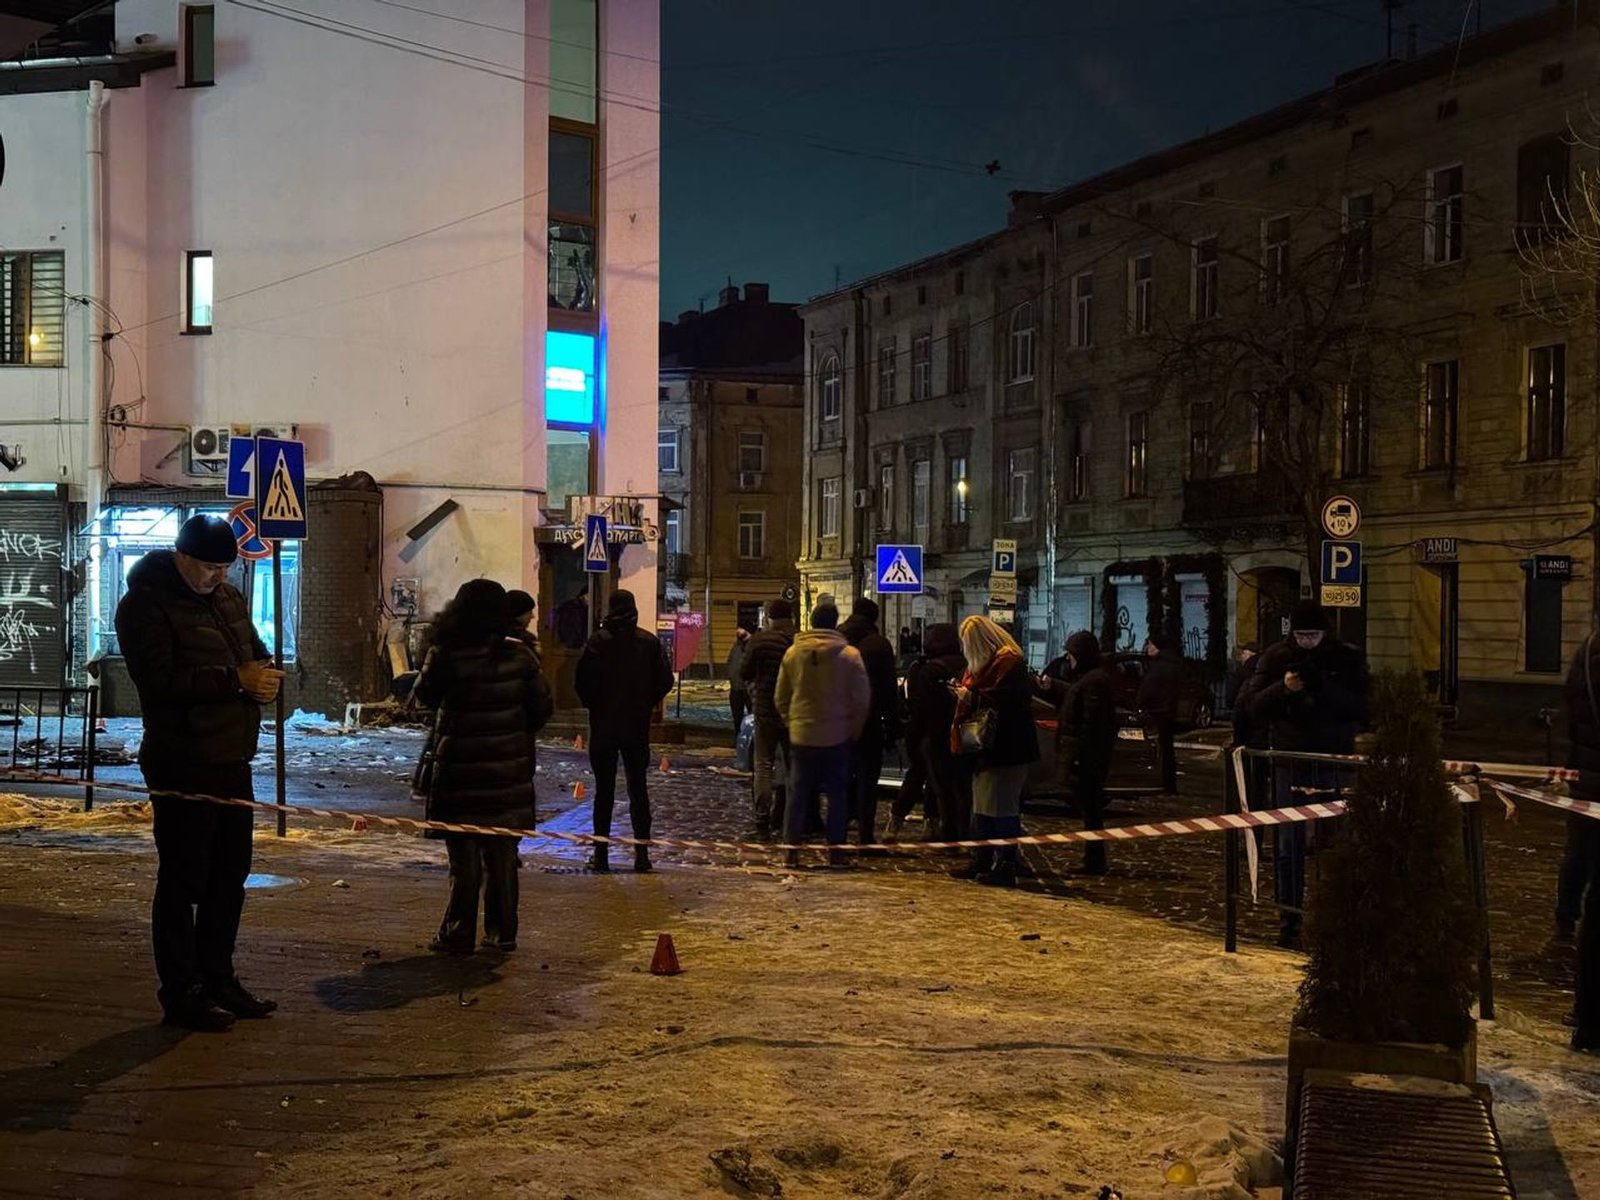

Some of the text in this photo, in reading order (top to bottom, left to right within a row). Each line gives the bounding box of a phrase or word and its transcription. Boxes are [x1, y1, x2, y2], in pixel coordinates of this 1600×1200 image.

[1426, 538, 1455, 552] ANDI
[999, 553, 1010, 570] P
[1331, 546, 1352, 579] P
